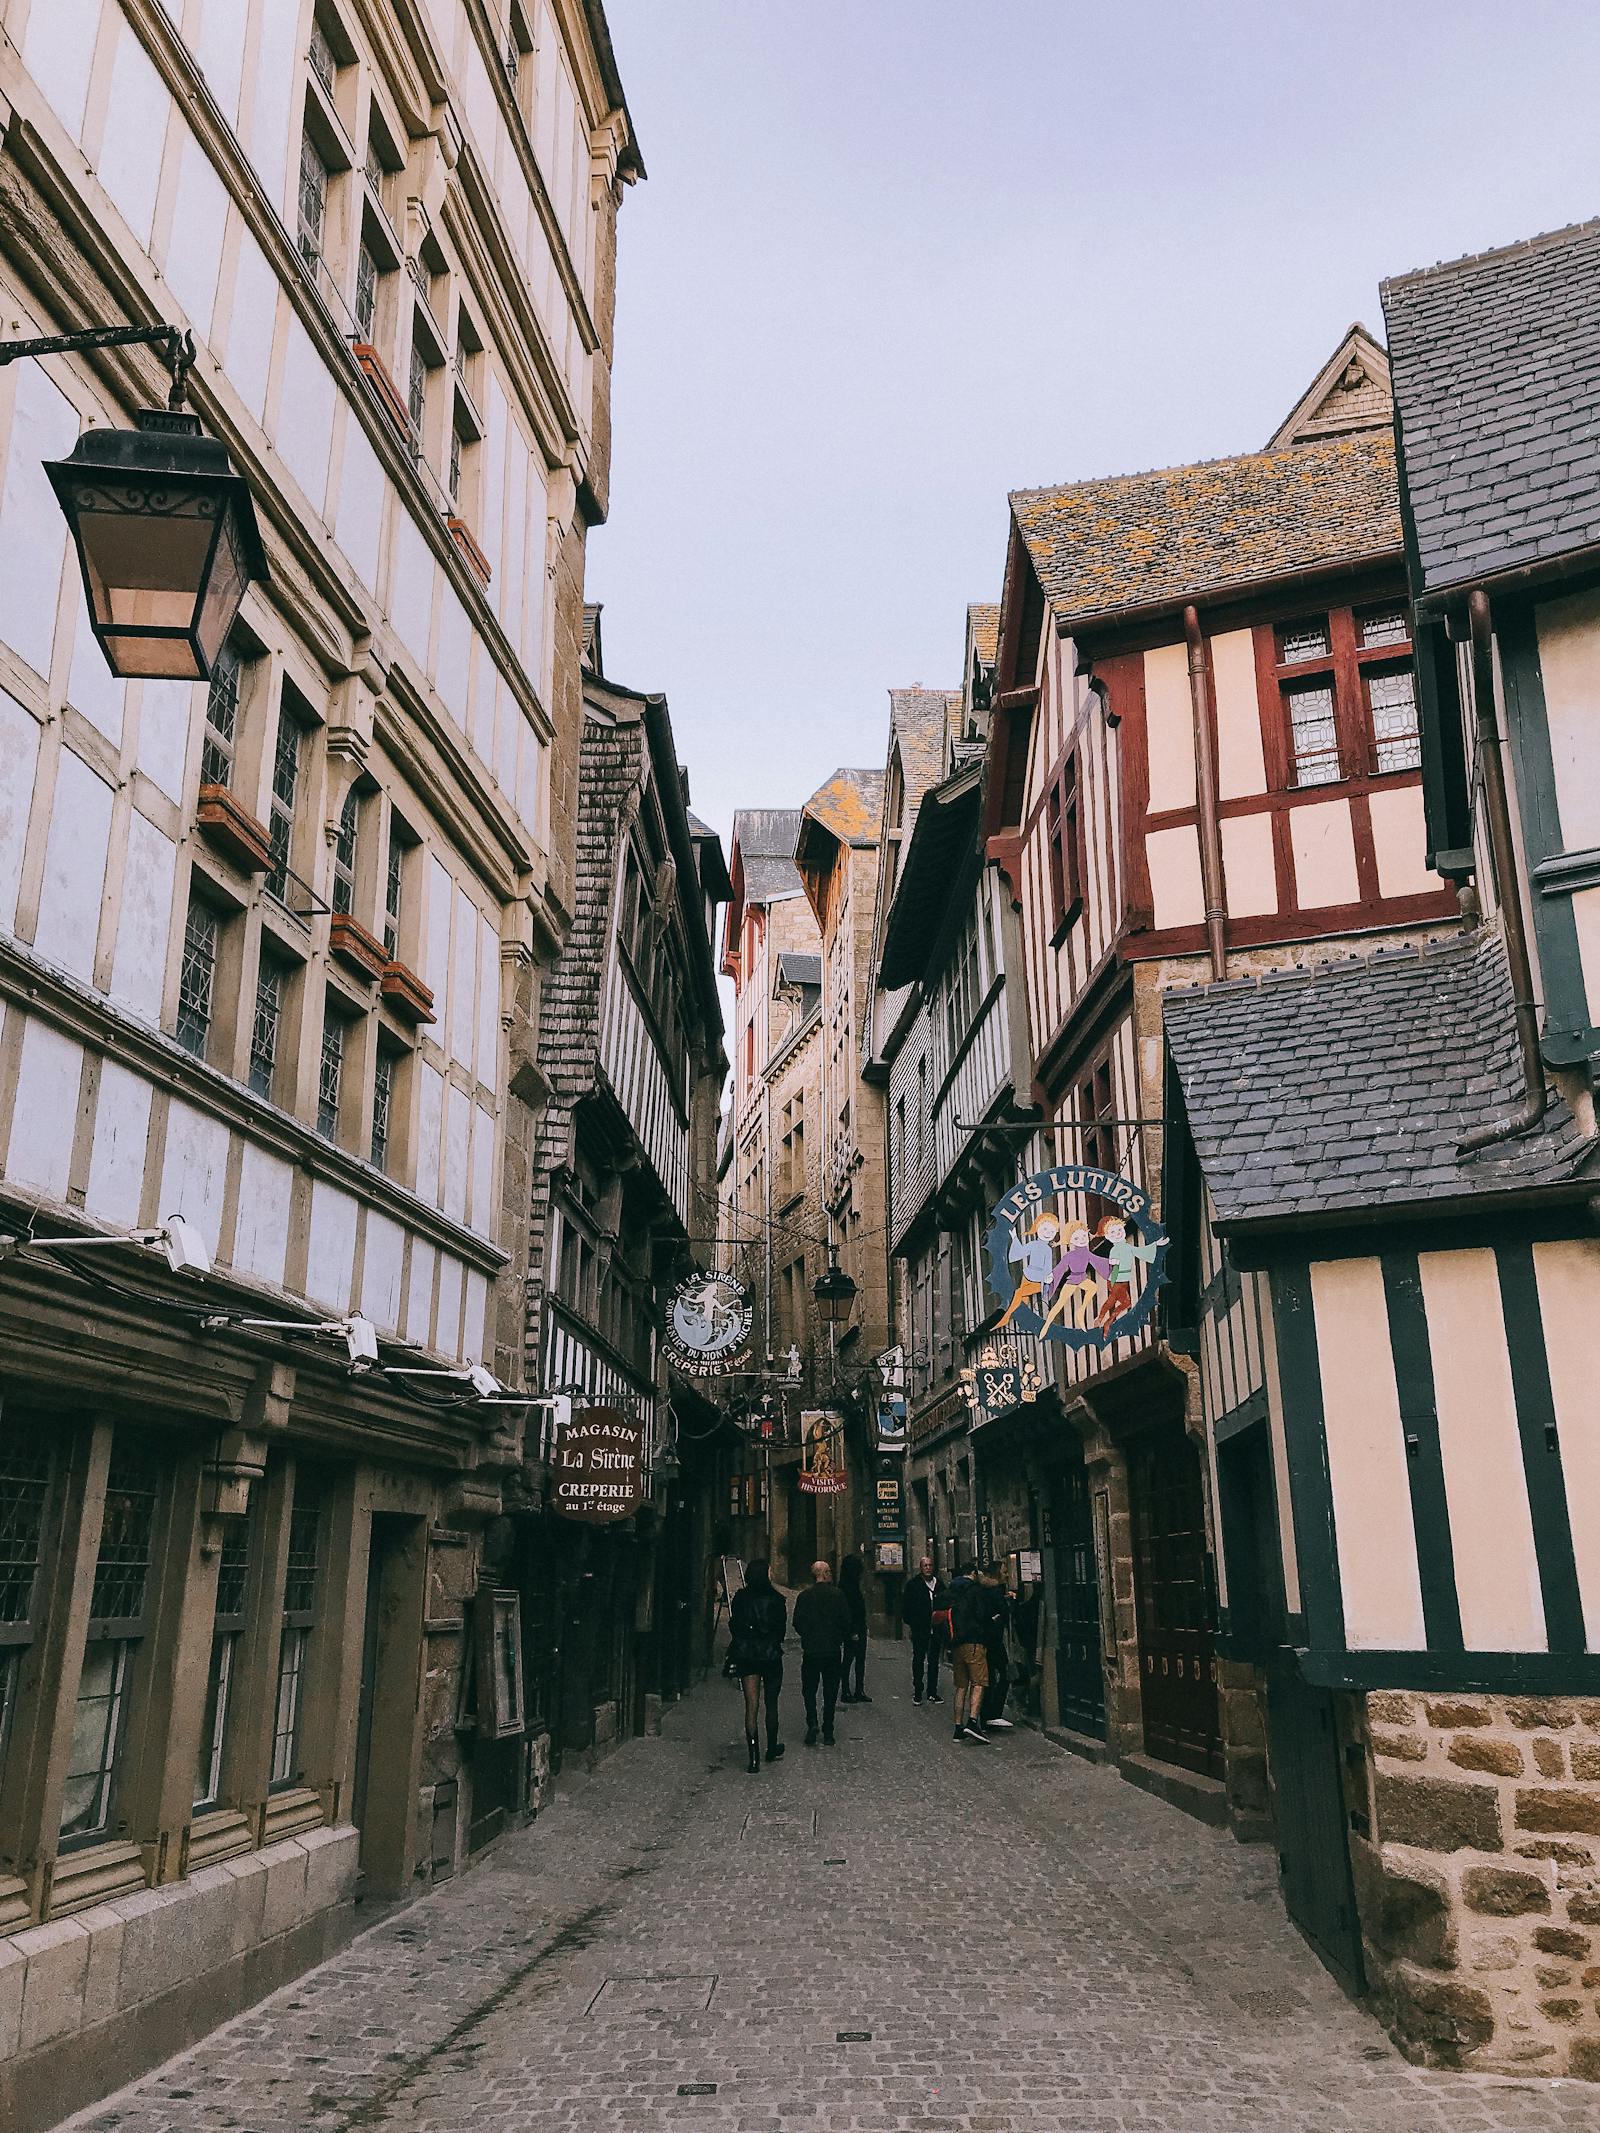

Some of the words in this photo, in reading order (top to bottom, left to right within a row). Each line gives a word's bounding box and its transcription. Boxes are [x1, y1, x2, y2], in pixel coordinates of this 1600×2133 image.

[1000, 1182, 1043, 1223] LES
[1050, 1171, 1145, 1214] LUTINS
[705, 1270, 746, 1296] SIRENE
[665, 1298, 687, 1352] SOUVENIRS
[687, 1348, 699, 1359] DU
[701, 1348, 728, 1360] MONT
[736, 1306, 753, 1343] MICHEL
[565, 1424, 638, 1443] MAGASIN
[561, 1449, 584, 1468] La
[589, 1447, 635, 1472] Sirène
[559, 1483, 634, 1498] CREPERIE
[801, 1482, 848, 1493] HISTORIQUE
[811, 1477, 836, 1486] VISITE
[565, 1503, 579, 1511] au
[597, 1501, 626, 1514] étage
[1043, 1512, 1052, 1543] BAR
[981, 1515, 990, 1566] PIZZAS
